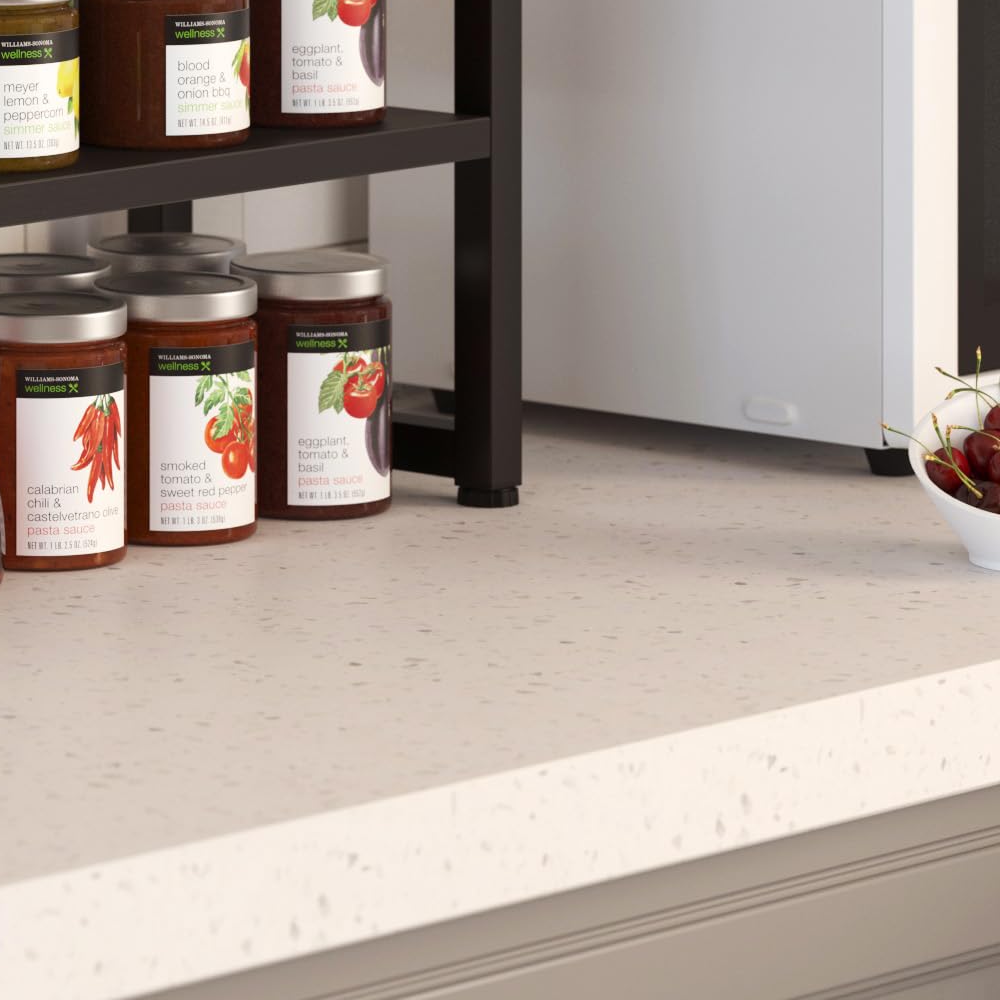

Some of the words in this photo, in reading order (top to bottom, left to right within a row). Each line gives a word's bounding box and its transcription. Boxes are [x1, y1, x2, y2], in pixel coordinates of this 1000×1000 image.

[174, 28, 215, 39] wellness
[1, 49, 42, 60] wellness
[177, 59, 210, 71] blood
[292, 56, 333, 67] tomato
[335, 55, 344, 66] &
[177, 75, 217, 87] orange
[219, 71, 227, 83] &
[292, 69, 318, 80] basil
[3, 81, 40, 94] meyer
[177, 87, 210, 100] onion
[212, 86, 232, 100] bbq
[292, 83, 324, 96] pasta
[3, 95, 39, 107] lemon
[42, 94, 49, 105] &
[177, 101, 217, 114] simmer
[3, 107, 65, 123] peppercorn
[3, 123, 45, 135] simmer
[296, 338, 337, 349] wellness
[158, 361, 200, 371] wellness
[24, 383, 67, 393] wellness
[298, 450, 338, 460] tomato
[342, 448, 349, 458] &
[159, 460, 206, 471] smoked
[298, 462, 324, 473] basil
[160, 474, 201, 485] tomato
[204, 473, 212, 483] &
[298, 475, 330, 488] pasta
[27, 484, 79, 495] calabrian
[160, 488, 194, 498] sweet
[198, 485, 216, 496] red
[218, 483, 248, 498] pepper
[27, 498, 50, 509] chili
[53, 497, 62, 508] &
[160, 501, 192, 513] pasta
[196, 500, 227, 511] sauce
[27, 509, 101, 522] castelvetrano
[102, 506, 119, 518] olive
[27, 525, 60, 537] pasta
[63, 524, 96, 535] sauce
